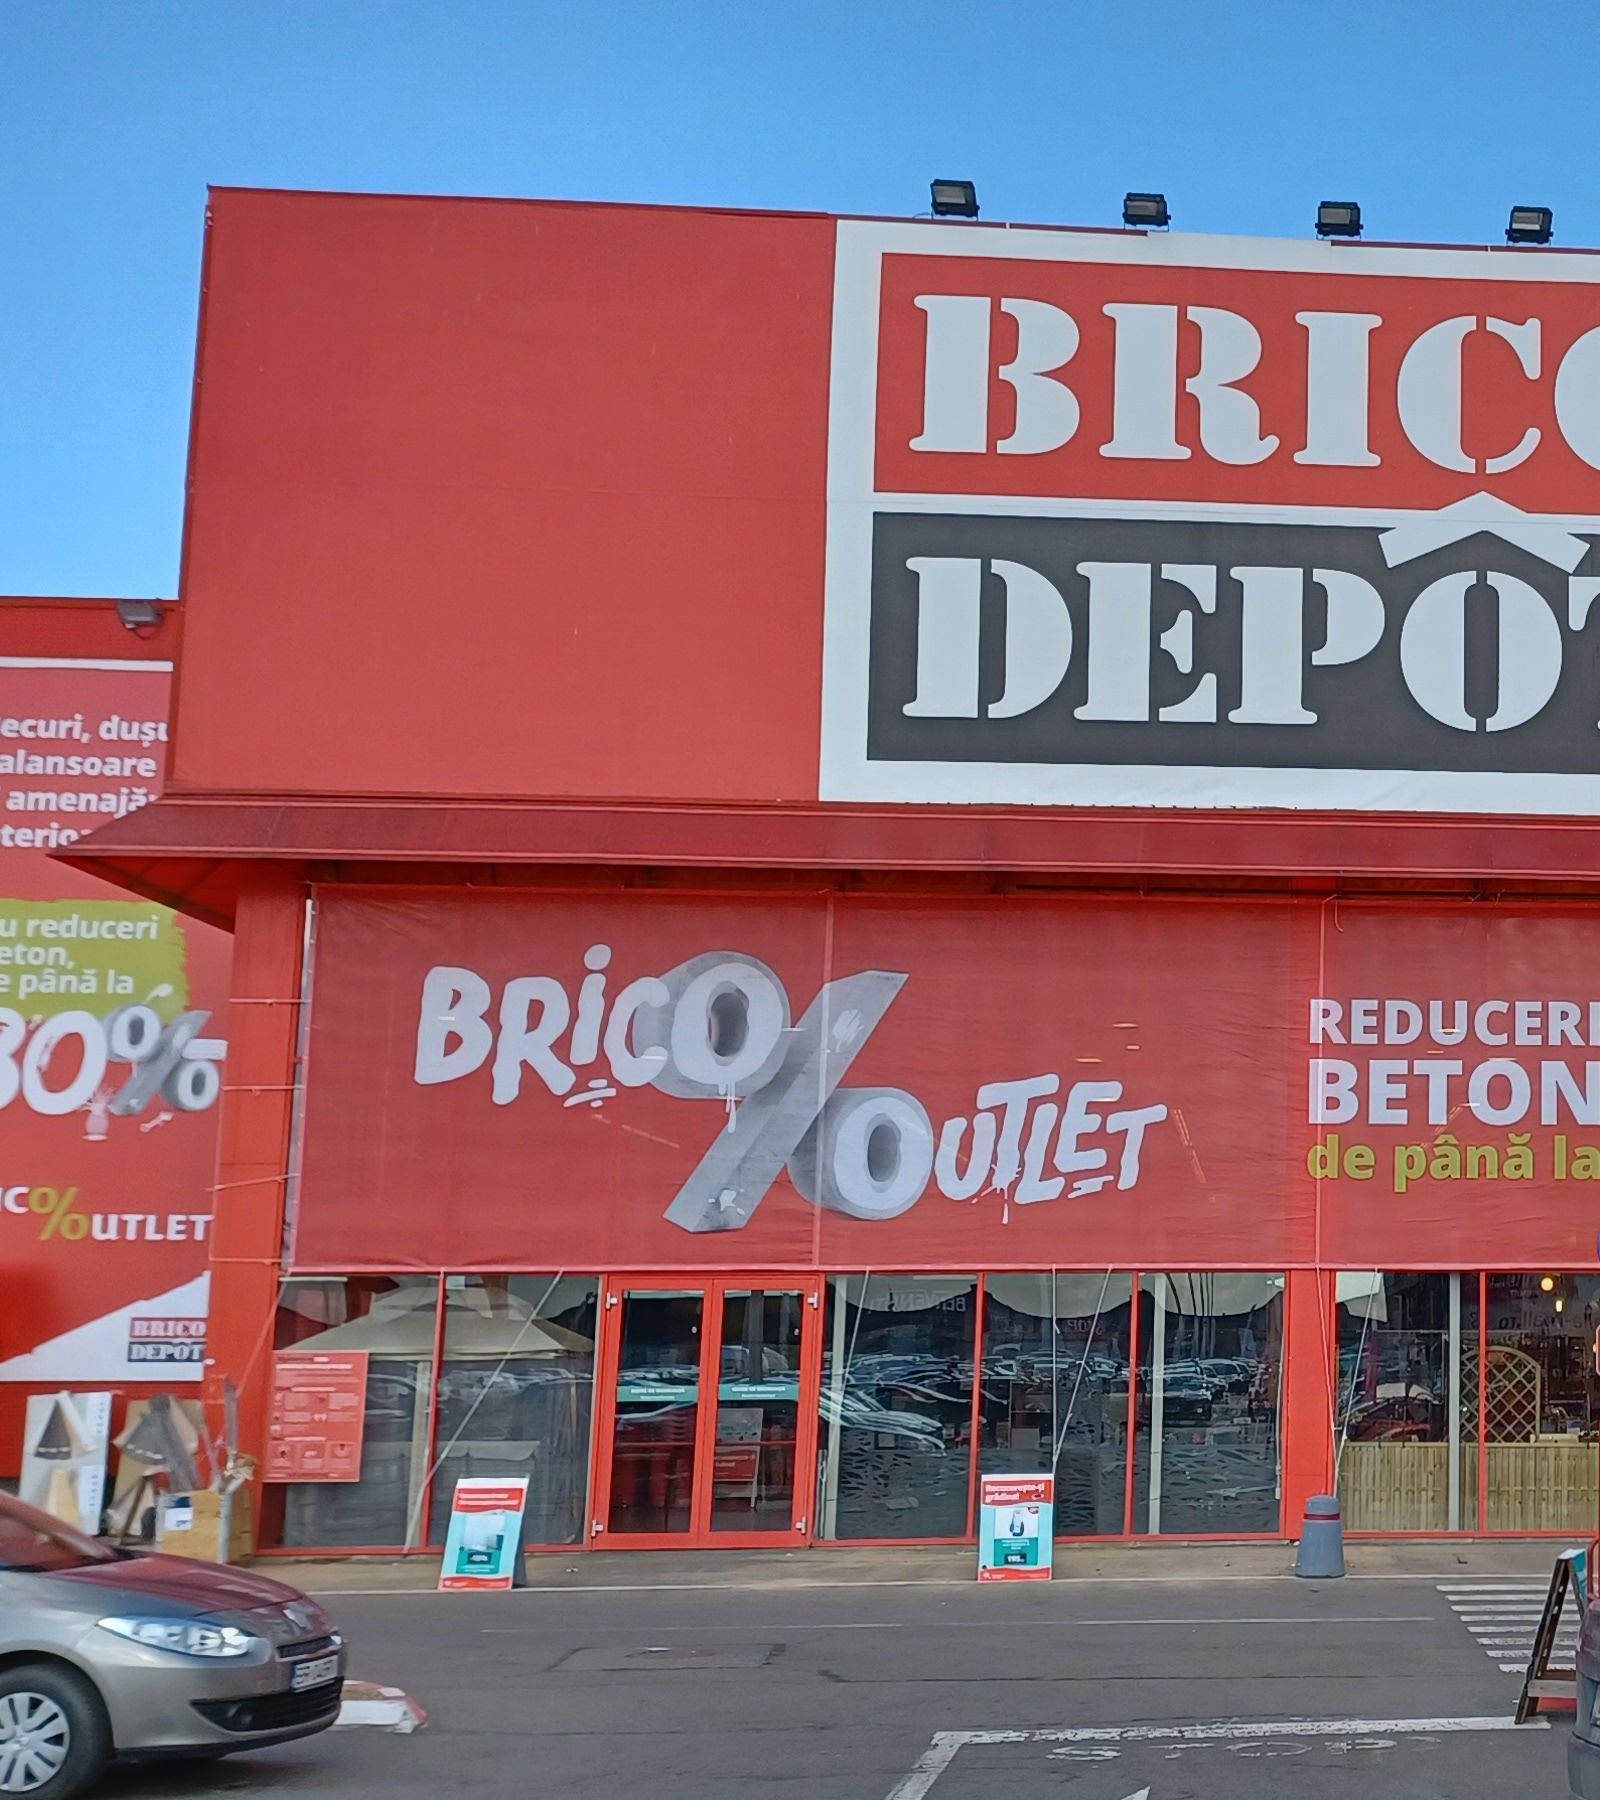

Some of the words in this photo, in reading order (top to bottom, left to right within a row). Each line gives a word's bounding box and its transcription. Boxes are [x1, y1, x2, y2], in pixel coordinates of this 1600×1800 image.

[0, 713, 91, 744] ecuri,
[0, 748, 156, 777] alansoare
[4, 786, 159, 820] amenajă
[0, 821, 94, 848] terio
[0, 918, 17, 938] u
[26, 914, 159, 939] reduceri
[0, 944, 75, 970] eton,
[18, 966, 97, 1000] până
[107, 968, 134, 994] la
[1306, 1133, 1374, 1181] de
[1394, 1133, 1535, 1193] până
[133, 1320, 207, 1337] BRICO
